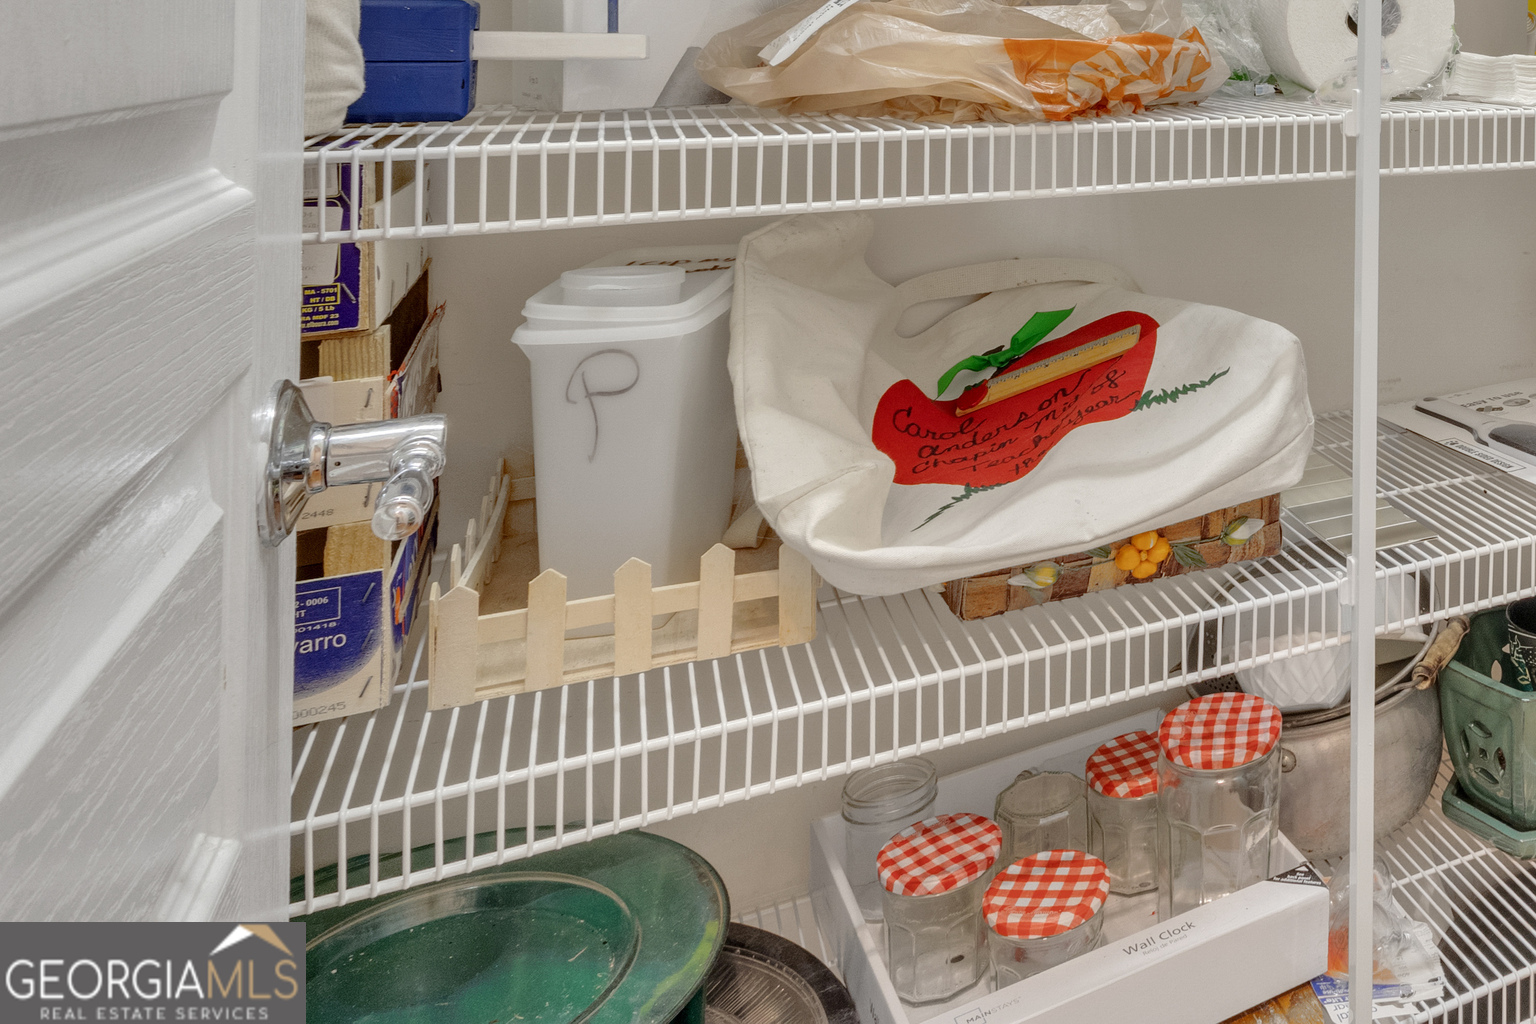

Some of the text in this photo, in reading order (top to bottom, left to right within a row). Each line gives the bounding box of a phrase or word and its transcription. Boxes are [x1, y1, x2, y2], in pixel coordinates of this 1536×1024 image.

[566, 348, 640, 463] P
[892, 408, 987, 441] Carol
[1122, 920, 1196, 956] Wall Clock
